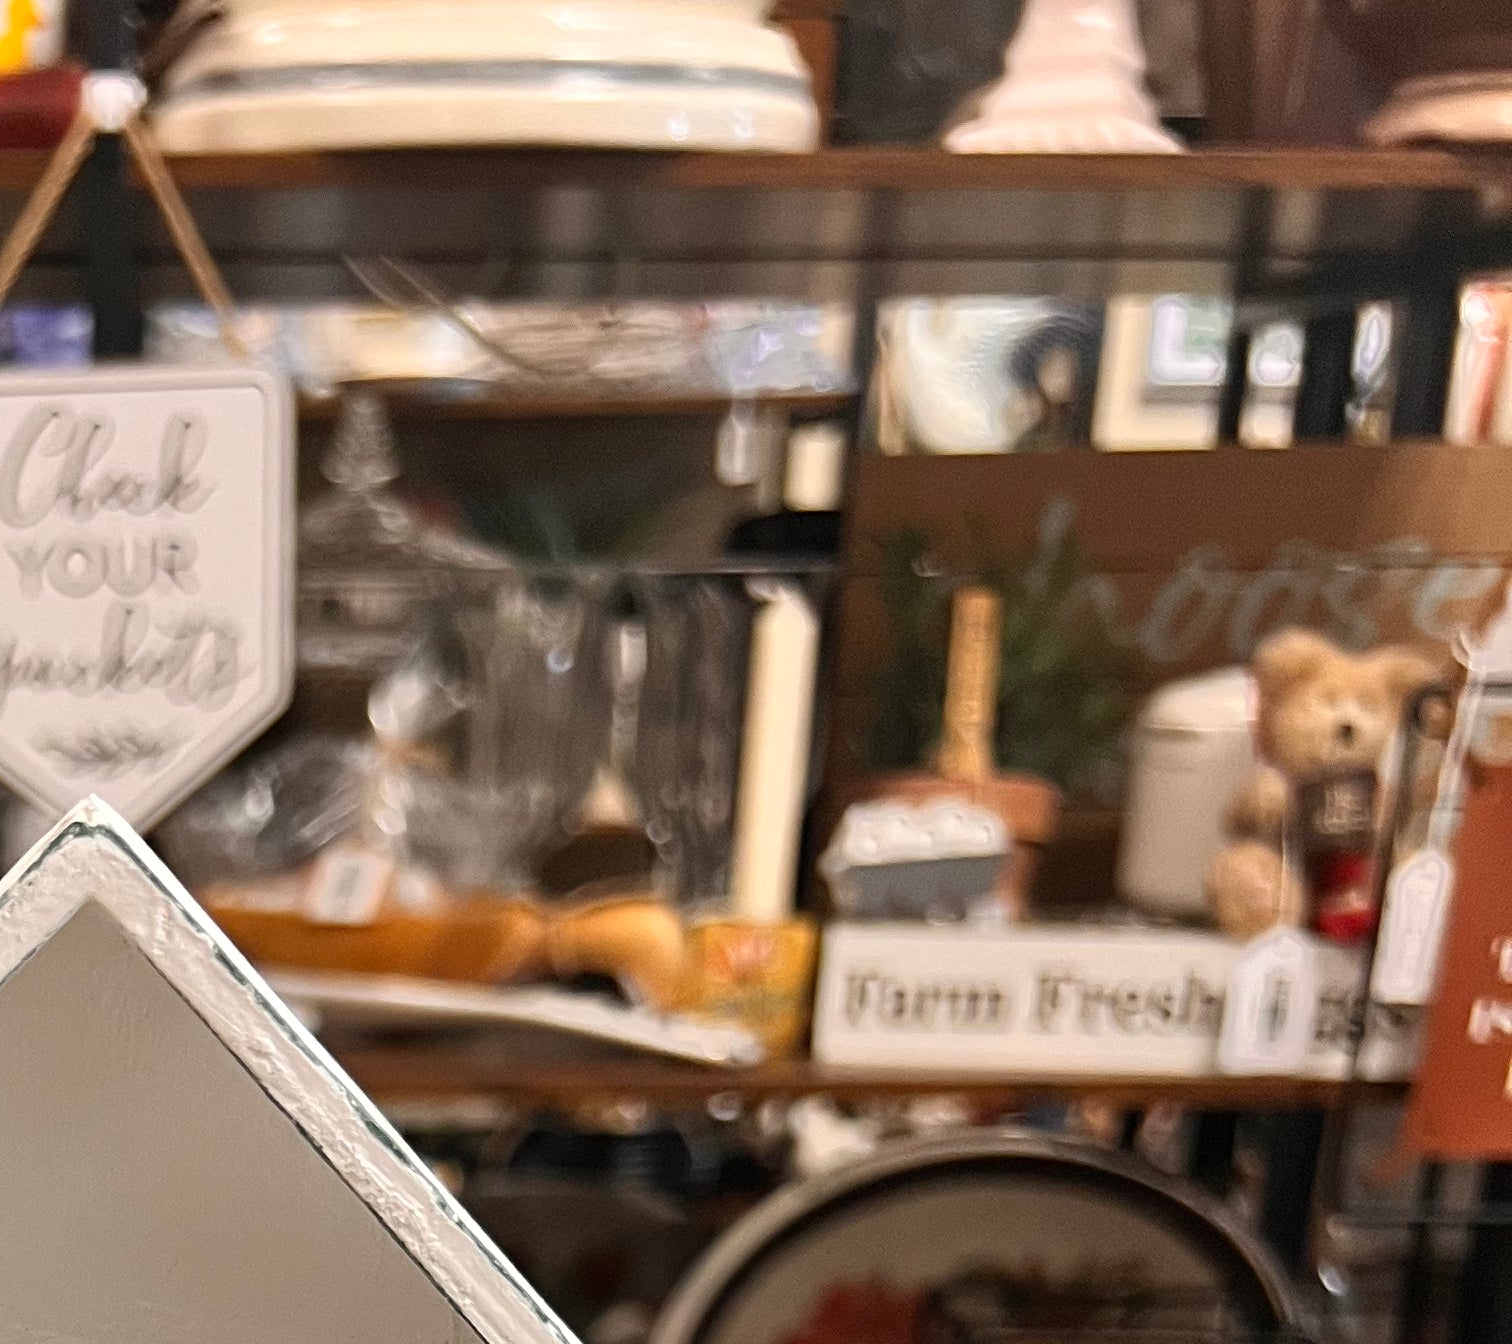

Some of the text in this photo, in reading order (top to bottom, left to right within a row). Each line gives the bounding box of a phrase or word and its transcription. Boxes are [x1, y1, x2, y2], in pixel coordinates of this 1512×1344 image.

[4, 531, 201, 599] YOUR
[846, 970, 1006, 1030] Farm
[1033, 966, 1227, 1036] Fresh
